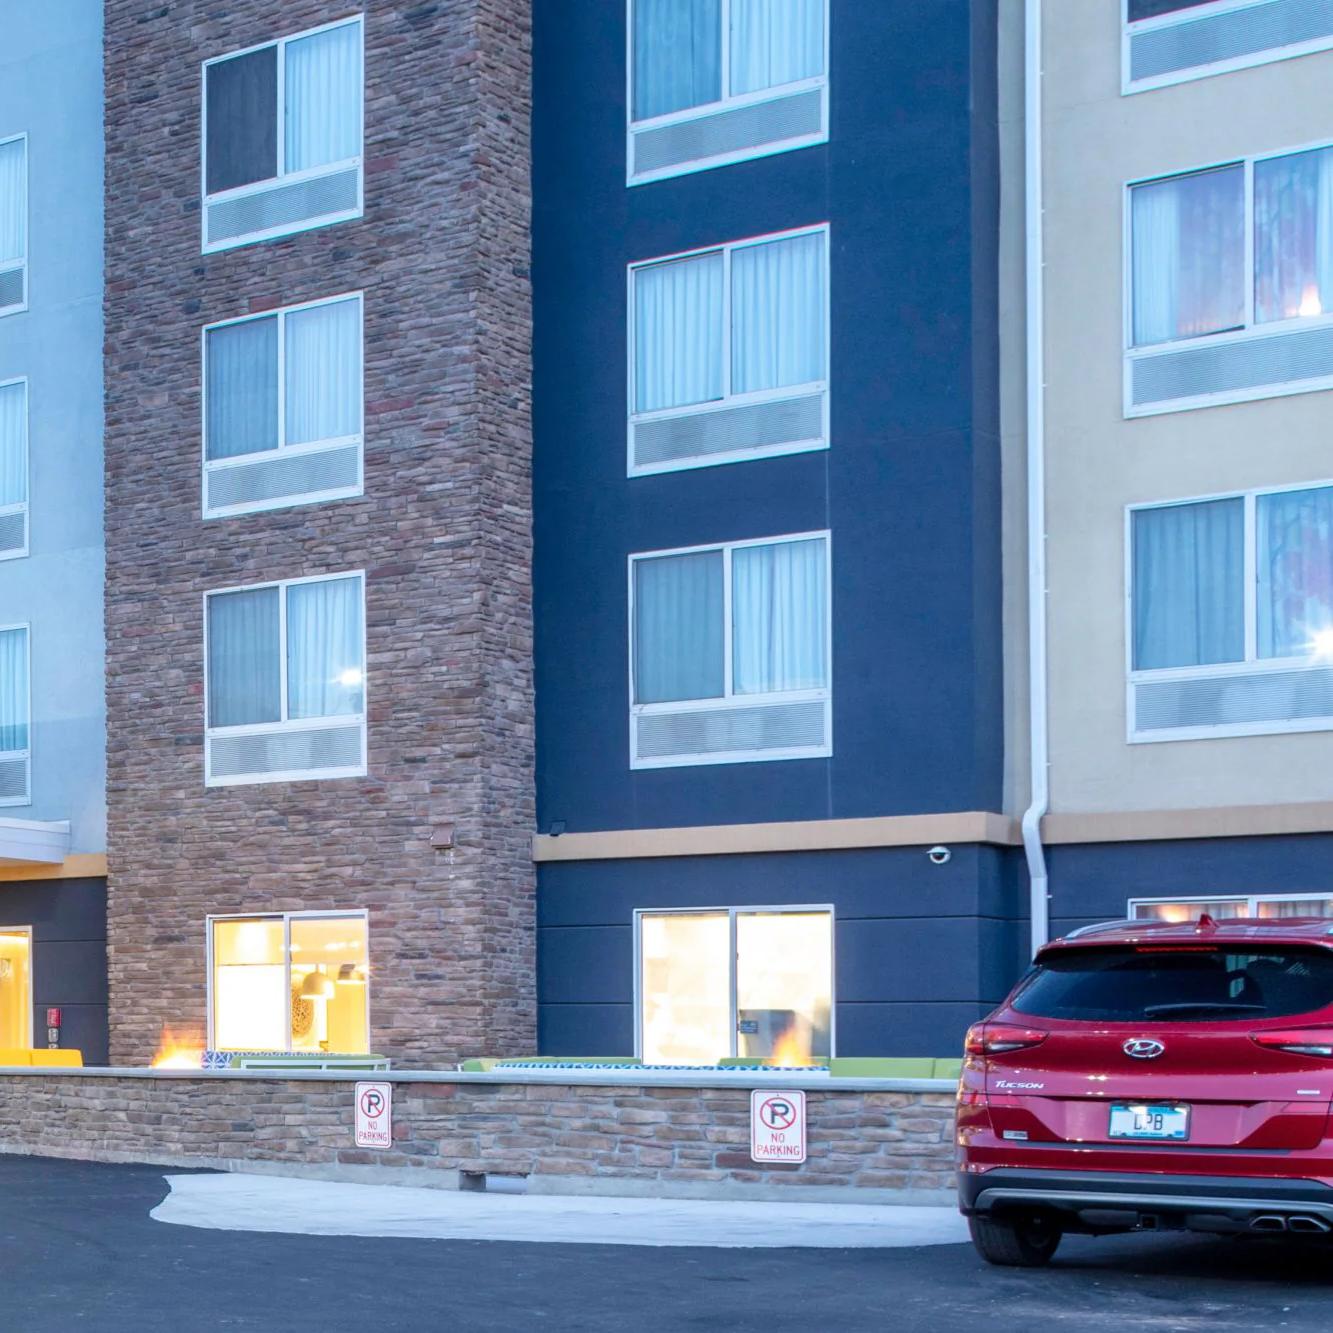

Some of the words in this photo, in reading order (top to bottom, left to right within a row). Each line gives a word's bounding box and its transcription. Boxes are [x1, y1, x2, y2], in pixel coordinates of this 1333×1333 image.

[995, 1080, 1044, 1089] TUCSON
[368, 1121, 378, 1130] NO
[359, 1131, 387, 1141] PARKING
[771, 1132, 785, 1143] NO
[757, 1145, 800, 1156] PARKING
